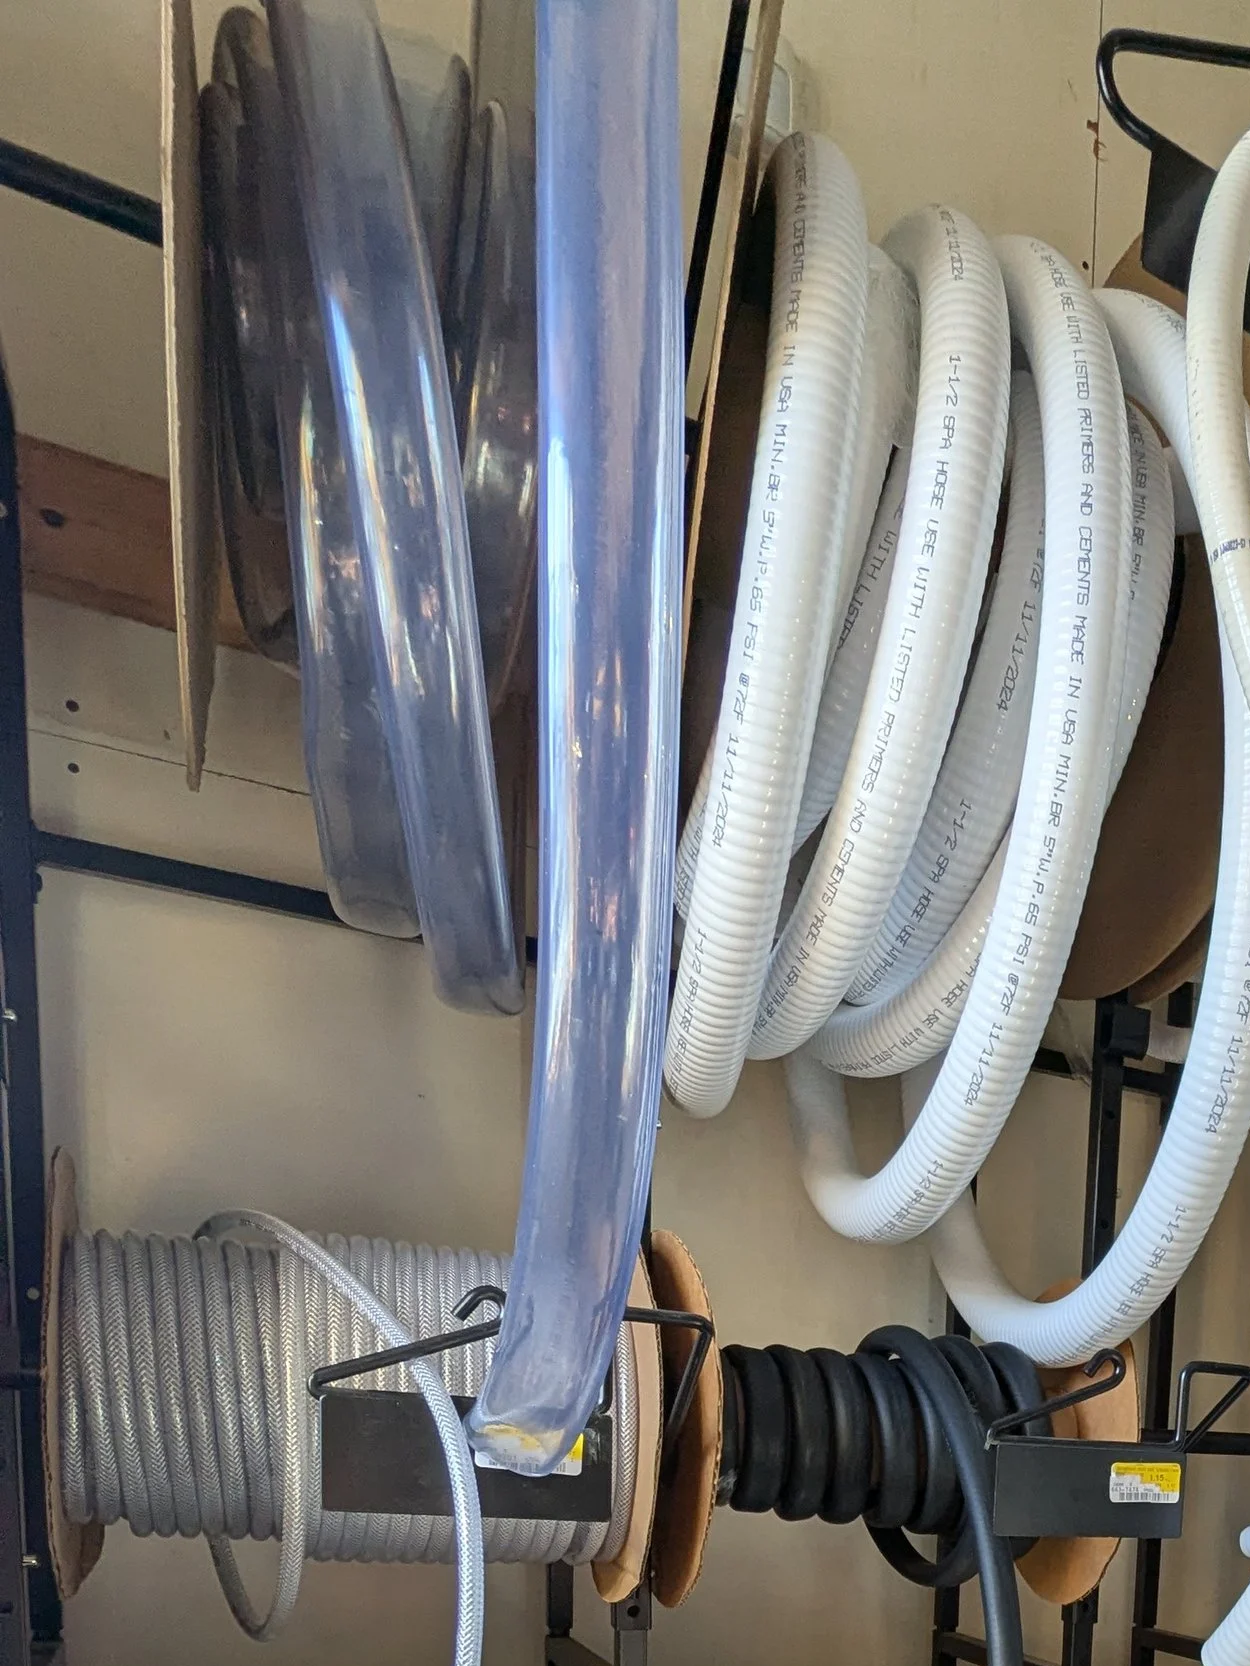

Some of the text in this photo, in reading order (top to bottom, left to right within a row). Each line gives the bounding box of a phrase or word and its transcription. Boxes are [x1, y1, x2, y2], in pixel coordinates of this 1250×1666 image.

[785, 290, 803, 333] MADE
[1065, 315, 1083, 345] WITH
[782, 345, 796, 366] IN
[1072, 349, 1091, 400] LISTED
[777, 376, 793, 414] USA
[947, 354, 962, 407] 1-1/2
[939, 414, 956, 450] SPA
[1077, 407, 1095, 475] PRIMERS
[930, 459, 949, 511] HOSE
[1079, 482, 1094, 517] AND
[869, 530, 897, 581] WITH
[920, 518, 940, 559] USE
[1075, 526, 1093, 606] CEMENTS
[907, 566, 931, 619] WITH
[742, 621, 759, 662] PSI
[998, 599, 1037, 713] 11/11/2024
[1070, 616, 1089, 664] MADE
[885, 627, 917, 702] LISTED
[1064, 677, 1083, 700] IN
[1060, 708, 1078, 747] USA
[859, 711, 897, 796] PRIMERS
[711, 732, 740, 849] 11/11/2024
[1047, 754, 1073, 829] MIN.BR
[847, 797, 869, 837] AND
[944, 798, 974, 854] 1-1/2
[821, 836, 856, 909] CEMENTS
[930, 854, 952, 887] SPA
[910, 887, 935, 923] HOSE
[805, 908, 829, 946] MADE
[895, 924, 916, 948] USE
[691, 927, 709, 974] 1-1/2
[798, 947, 811, 967] IN
[1012, 933, 1033, 966] PSI
[686, 976, 700, 1002] SPA
[787, 965, 802, 988] USA
[941, 979, 968, 1009] HOSE
[1000, 972, 1020, 1017] @72F
[900, 1027, 924, 1049] WITH
[922, 1008, 944, 1029] USE
[963, 1021, 1004, 1107] 11/11/2024
[1205, 1034, 1245, 1135] 11/11/2024
[920, 1158, 944, 1190] 1-1/2
[1160, 1203, 1188, 1243] 1-1/2
[1146, 1245, 1168, 1269] SPA
[1129, 1272, 1153, 1297] HOSE
